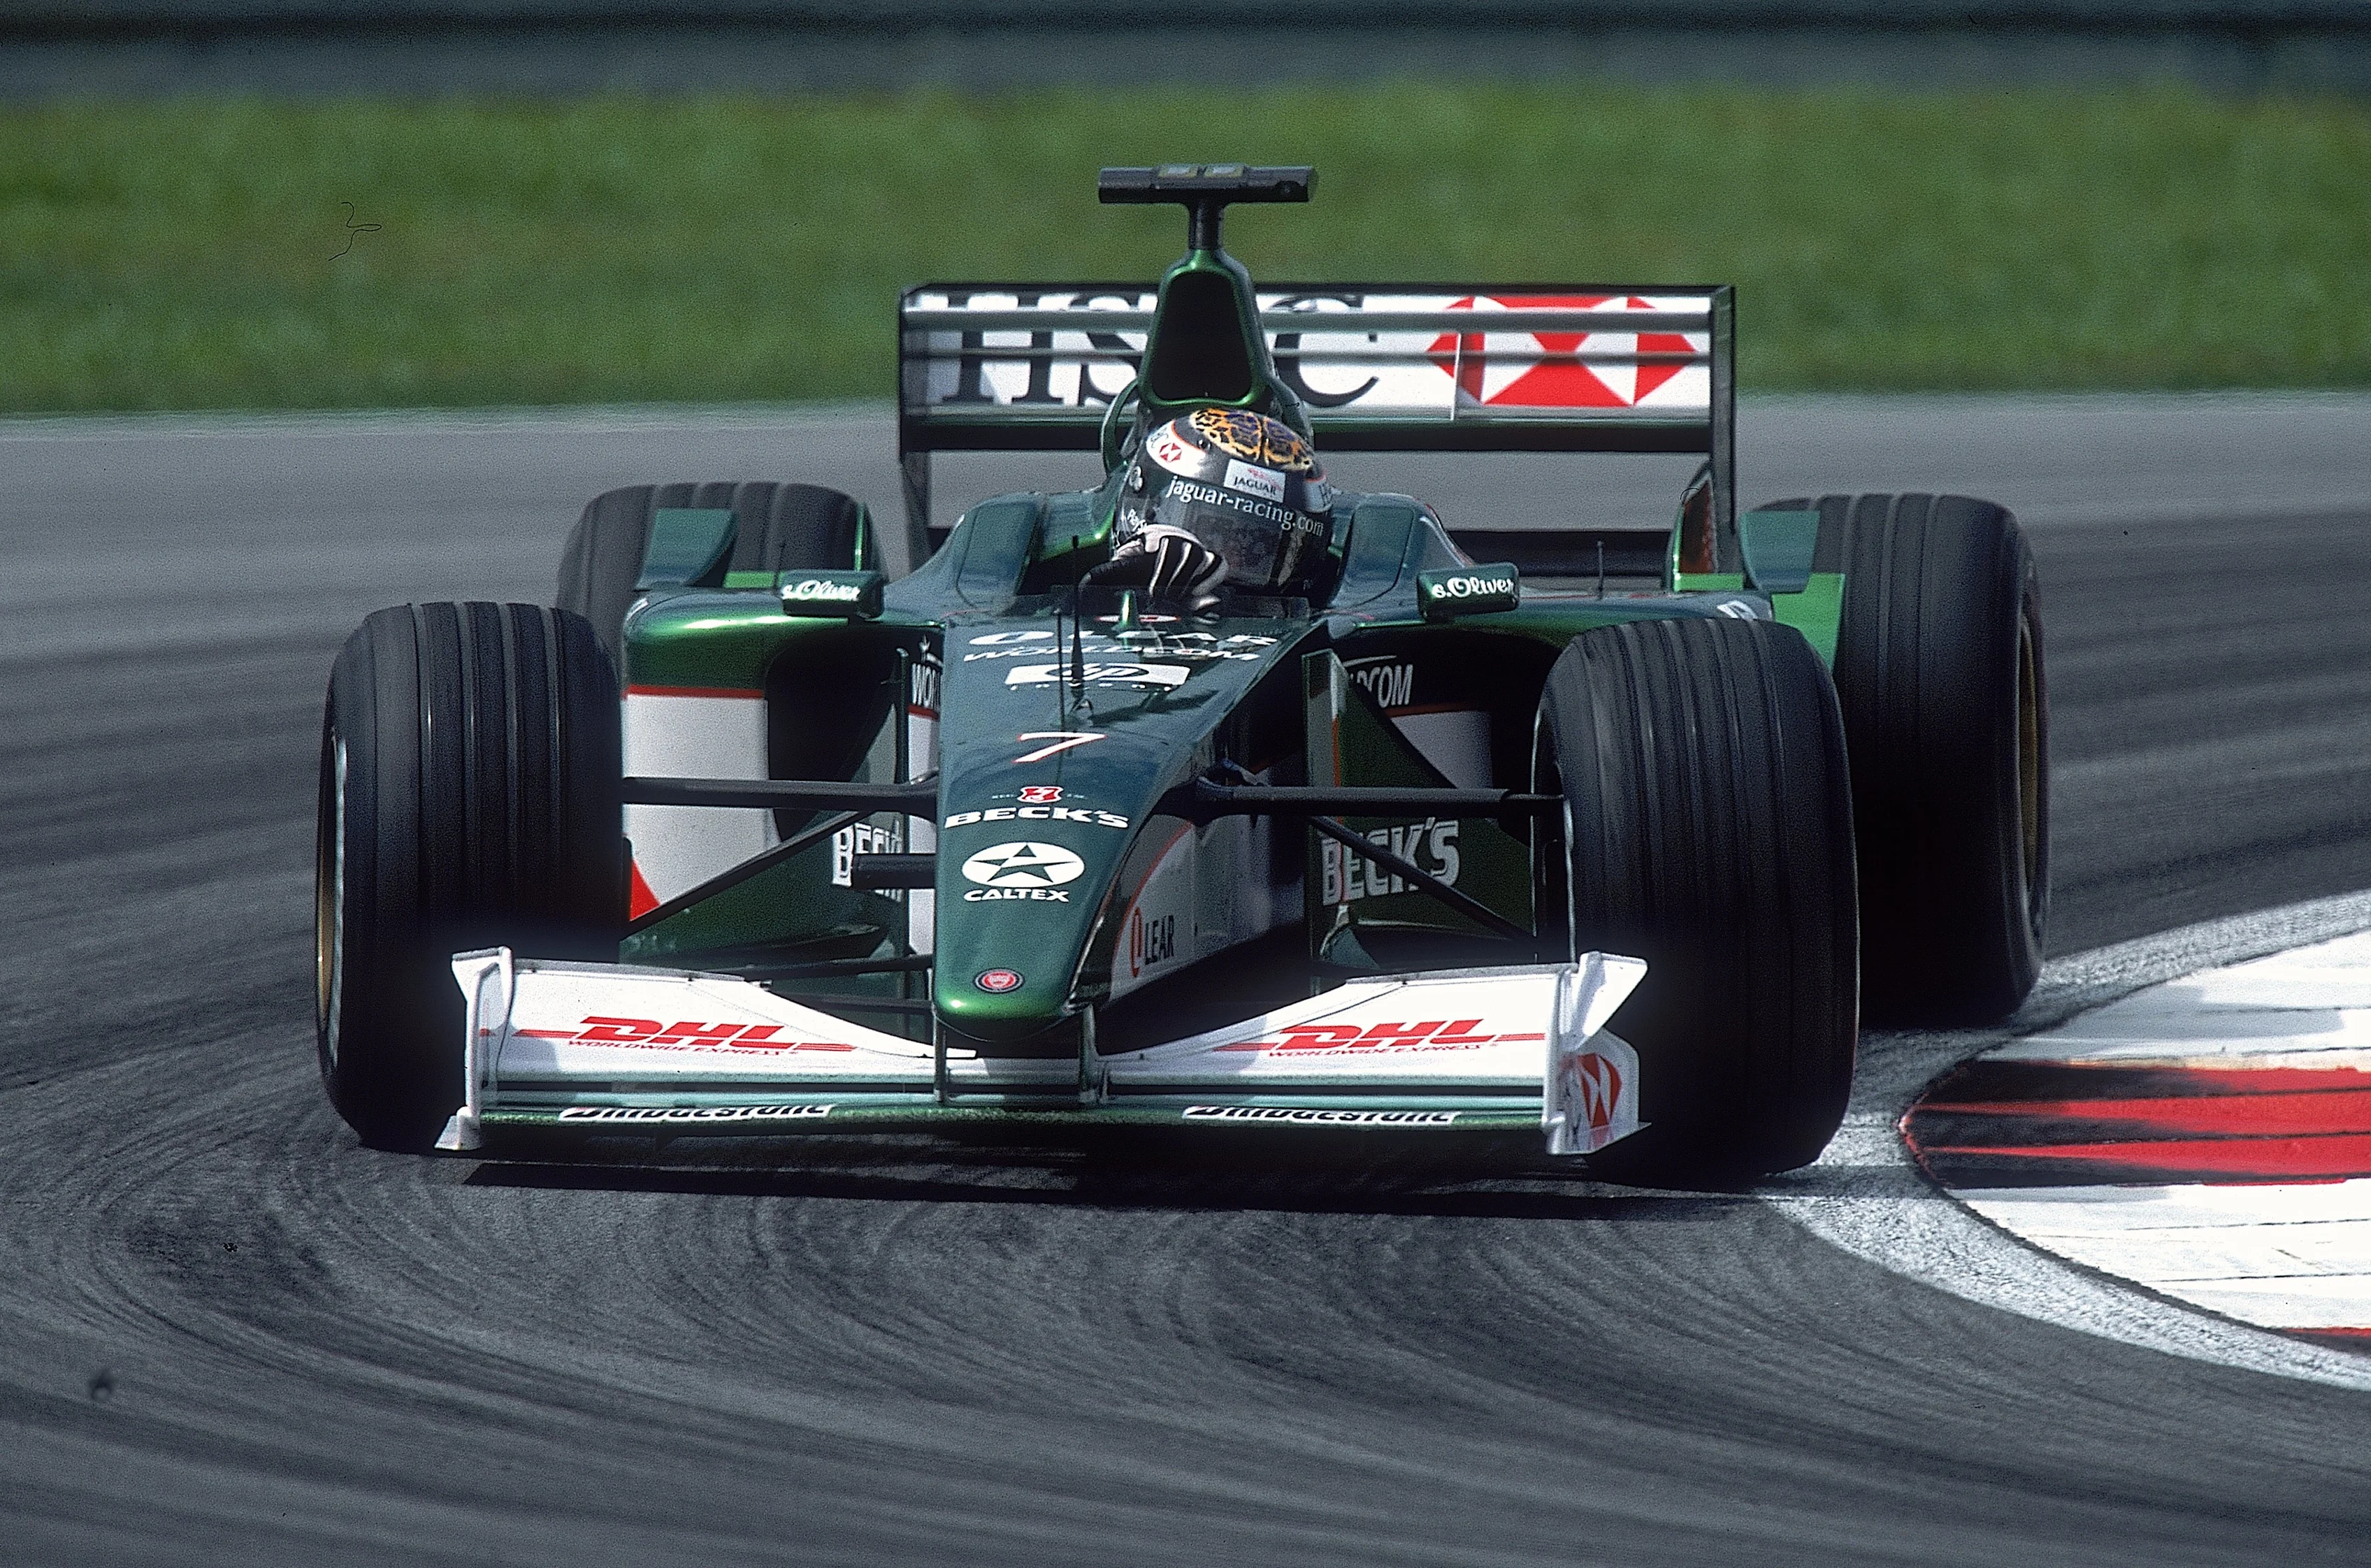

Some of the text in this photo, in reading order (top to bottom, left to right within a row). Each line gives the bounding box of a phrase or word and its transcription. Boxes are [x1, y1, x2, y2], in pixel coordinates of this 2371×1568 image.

[940, 293, 1380, 408] HSC
[1234, 477, 1276, 496] JAGUAR
[1165, 475, 1324, 537] jaguar-racing.com
[1432, 577, 1514, 598] s.Oliver
[1011, 731, 1107, 763] 7
[944, 806, 1129, 828] BECK'S
[1321, 817, 1460, 906] BECK'S
[963, 889, 1069, 902] CALTEX
[1144, 915, 1174, 965] LEAR
[568, 1040, 784, 1056] WORLDWIDE EXPRESS
[575, 1016, 797, 1049] DHL
[1275, 1019, 1494, 1050] DHL
[1268, 1044, 1485, 1058] WORLDWIDE EXPRESS
